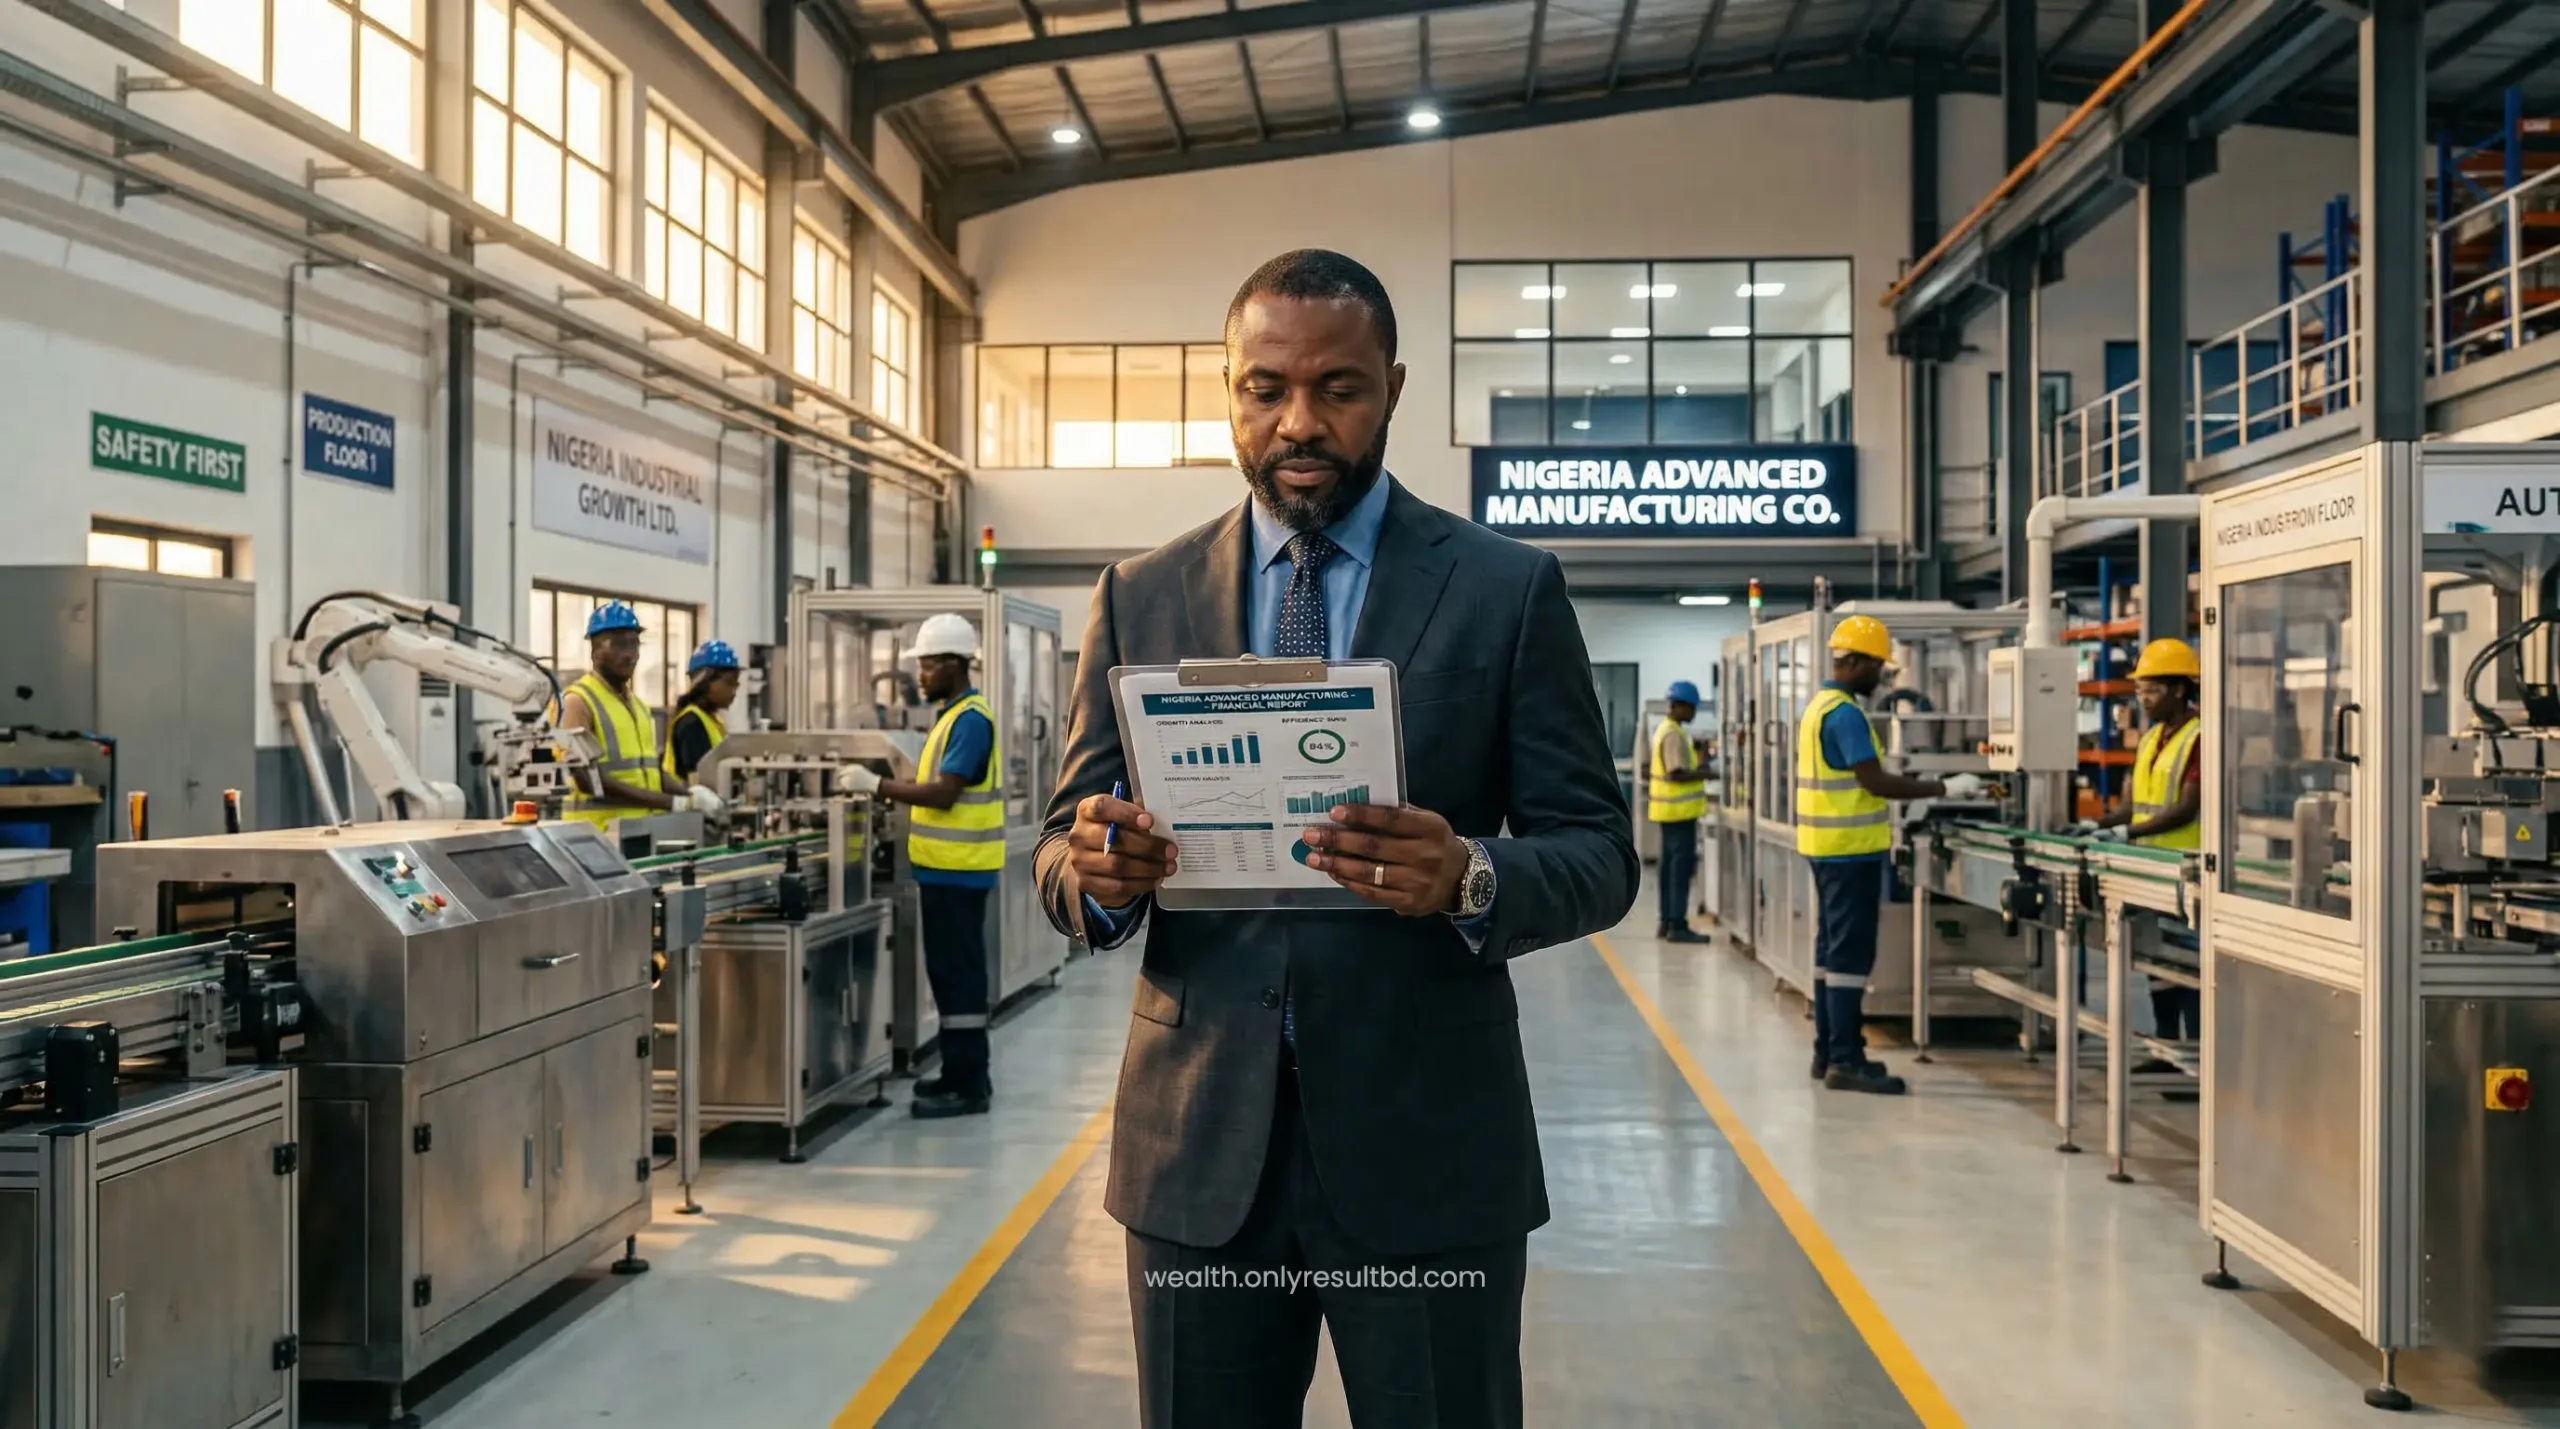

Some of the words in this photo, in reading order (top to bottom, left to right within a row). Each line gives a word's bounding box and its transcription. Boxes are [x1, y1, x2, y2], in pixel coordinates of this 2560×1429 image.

[307, 407, 393, 447] PRODUCTION
[96, 424, 181, 470] SAFETY
[185, 443, 243, 482] FIRST
[324, 441, 369, 471] FLOOR
[369, 454, 377, 473] 1
[547, 429, 615, 479] NIGERIA
[619, 452, 703, 505] INDUSTRIAL
[1499, 460, 1636, 490] NIGERIA
[1639, 459, 1828, 490] ADVANCED
[578, 482, 647, 530] GROWTH
[650, 503, 679, 536] LTD.
[1486, 494, 1777, 525] MANUFACTURING
[1782, 493, 1841, 525] CO.
[2317, 496, 2356, 524] FLOOR
[1161, 695, 1201, 704] NIGERIA
